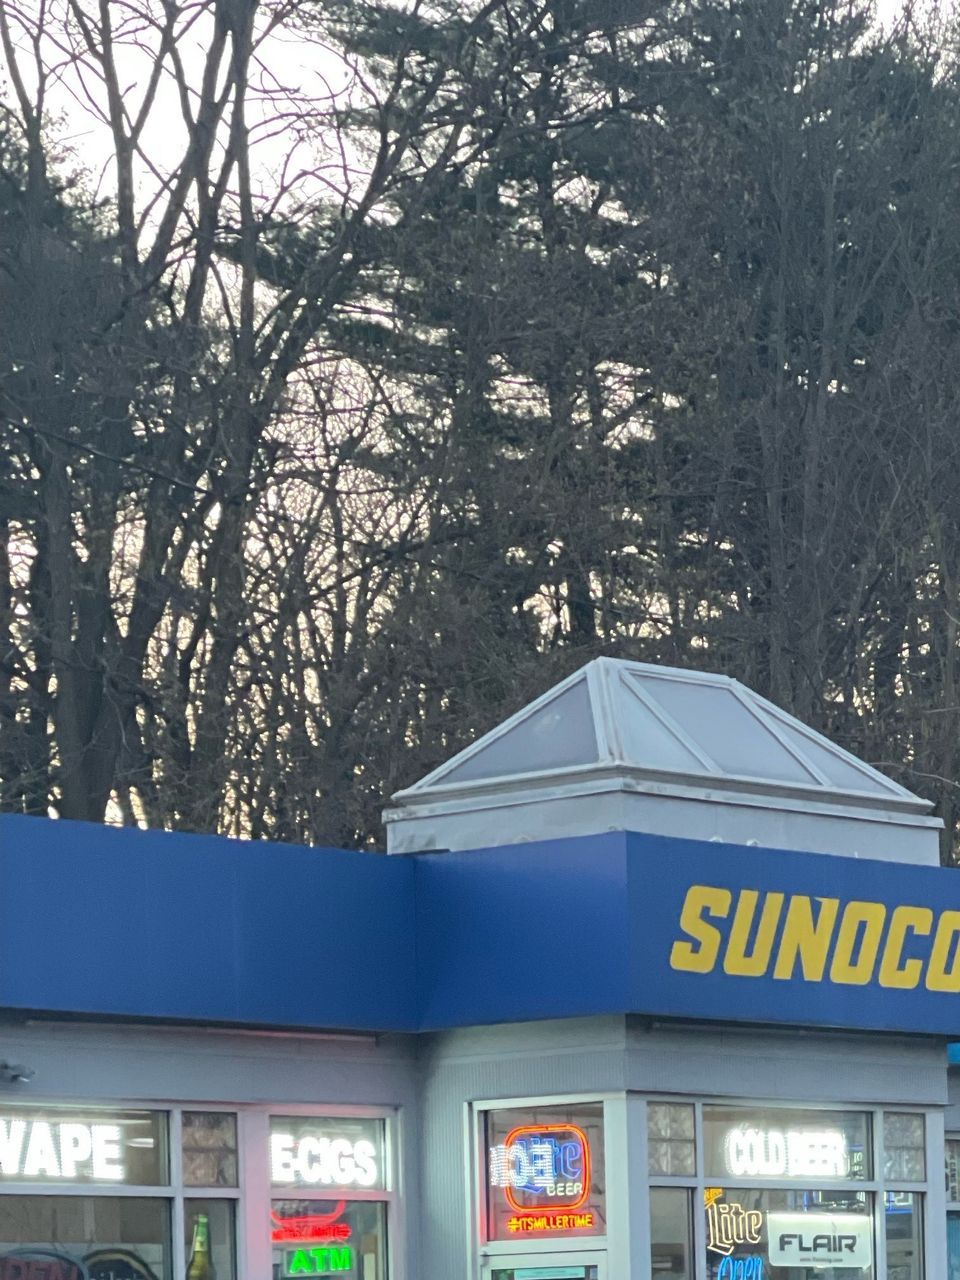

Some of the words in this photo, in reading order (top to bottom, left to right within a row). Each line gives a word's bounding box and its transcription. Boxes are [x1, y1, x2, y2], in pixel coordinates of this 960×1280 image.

[0, 1119, 124, 1180] VAPE
[725, 1127, 786, 1177] COLD
[546, 1182, 584, 1197] BEER
[507, 1213, 594, 1233] #ITSMILLERTIME
[706, 1201, 763, 1256] Lite
[778, 1232, 857, 1254] FLAIR
[289, 1246, 354, 1274] ATM
